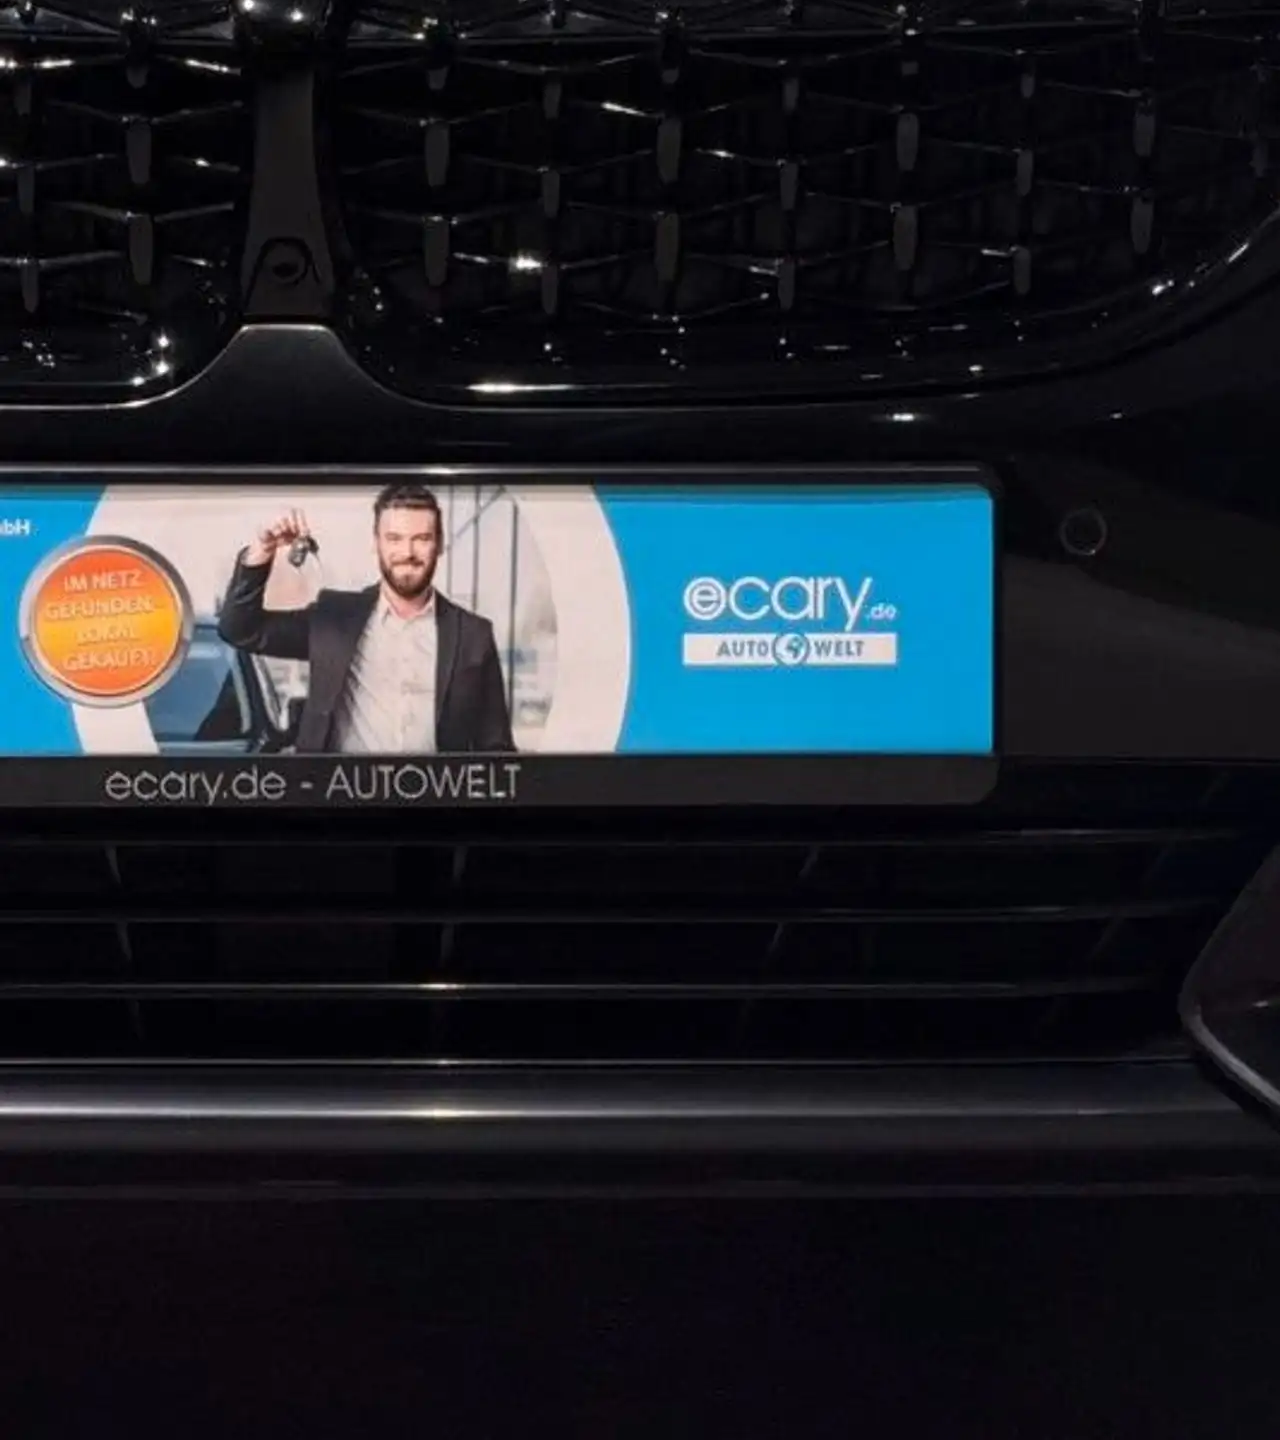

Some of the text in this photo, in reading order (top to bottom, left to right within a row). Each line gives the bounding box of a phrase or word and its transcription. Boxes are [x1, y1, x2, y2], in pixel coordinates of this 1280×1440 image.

[0, 518, 31, 536] bH
[64, 569, 144, 592] IM NETZ
[716, 640, 865, 657] AUTO WELT
[104, 764, 287, 806] ecary.de
[325, 763, 522, 800] AUTOWELT
